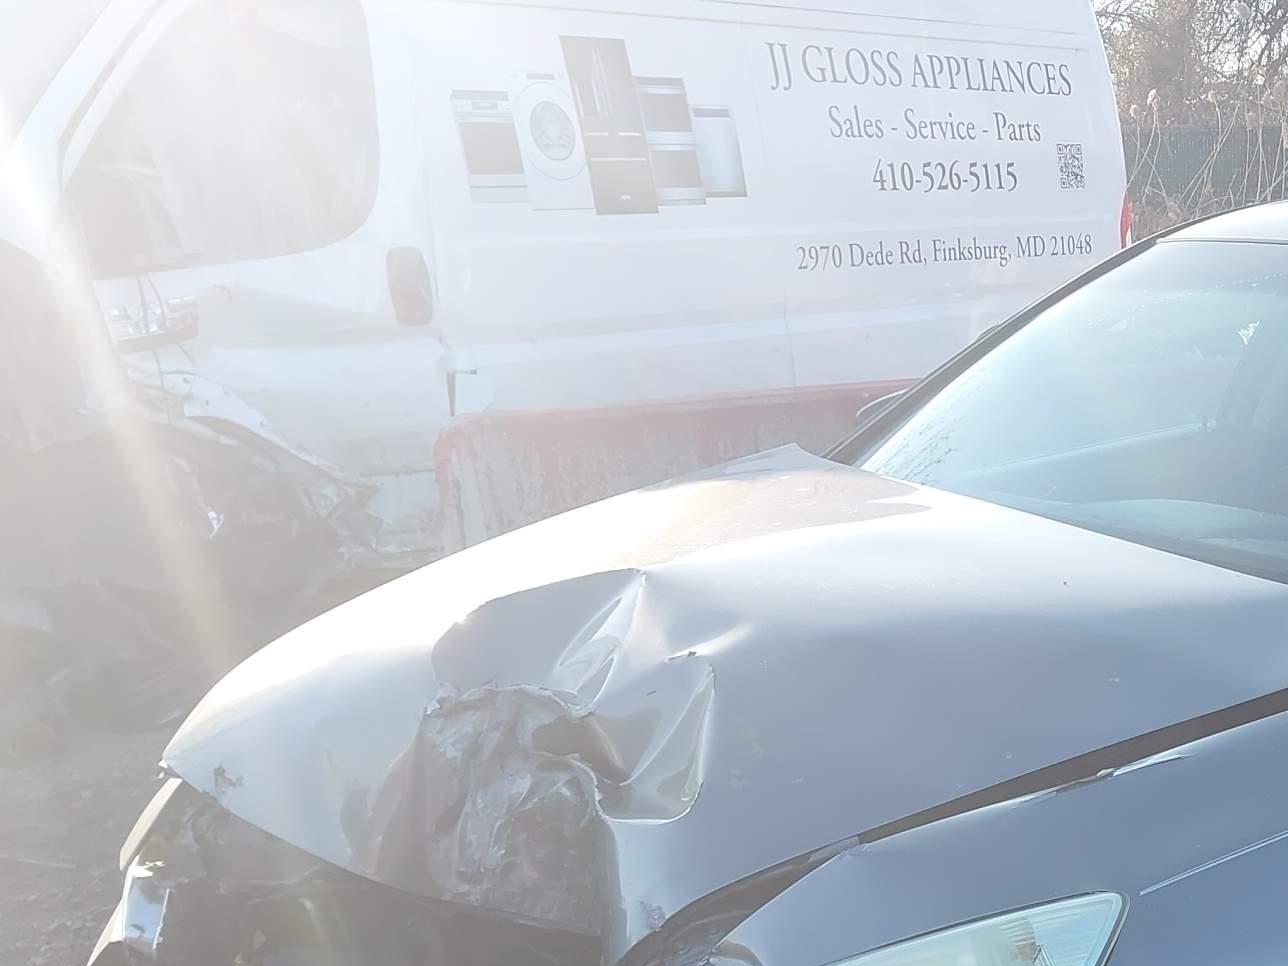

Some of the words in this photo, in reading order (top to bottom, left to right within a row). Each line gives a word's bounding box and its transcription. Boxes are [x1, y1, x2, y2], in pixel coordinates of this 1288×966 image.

[765, 42, 793, 91] JJ
[801, 45, 903, 88] GLOSS
[911, 53, 1072, 96] APPLIANCES
[828, 105, 884, 139] Sales
[904, 108, 976, 141] Service
[993, 111, 1041, 142] Parts
[873, 159, 1018, 192] 410-526-5115
[797, 245, 842, 270] 2970
[849, 241, 893, 268] Dede
[899, 240, 928, 266] Rd,
[932, 238, 1012, 267] Finksburg,
[1017, 235, 1045, 258] MD
[1050, 233, 1093, 257] 21048
